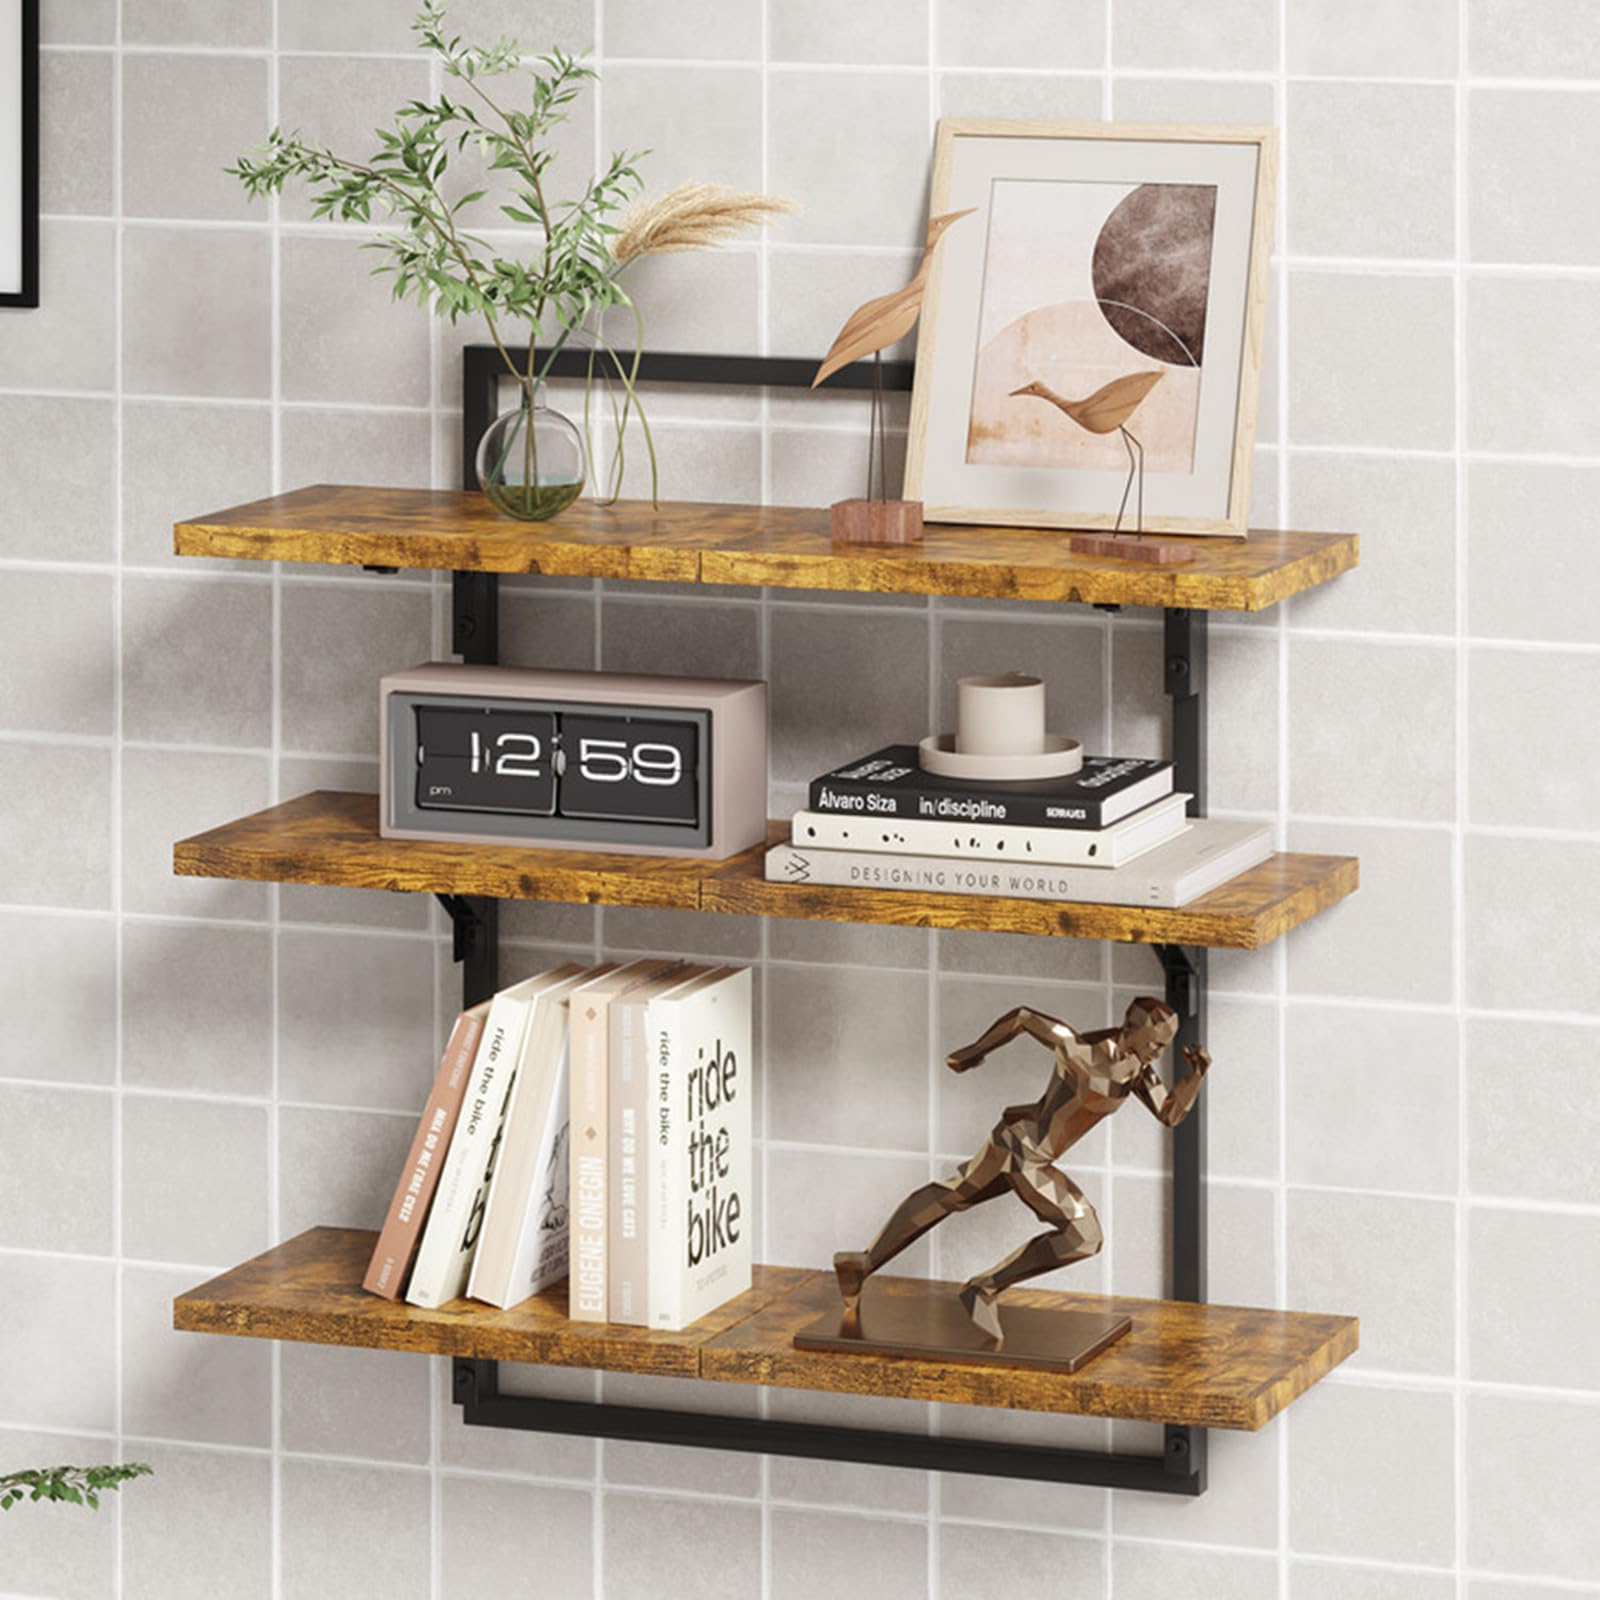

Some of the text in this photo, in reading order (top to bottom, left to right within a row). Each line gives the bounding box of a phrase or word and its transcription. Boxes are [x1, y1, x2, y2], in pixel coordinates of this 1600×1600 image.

[471, 732, 682, 785] 12 59
[430, 784, 452, 796] pm
[818, 786, 865, 810] Álvaro
[866, 793, 897, 813] Siza
[918, 796, 1007, 820] in/discipline
[850, 866, 1069, 894] DESIGNING YOUR WORLD
[659, 1031, 671, 1067] ride
[467, 1026, 504, 1136] ride the bike
[659, 1072, 671, 1102] the
[687, 1038, 737, 1122] ride
[659, 1107, 671, 1146] bike
[688, 1119, 730, 1193] the
[579, 1155, 603, 1312] EUGENE ONEGIN
[688, 1185, 741, 1268] bike
